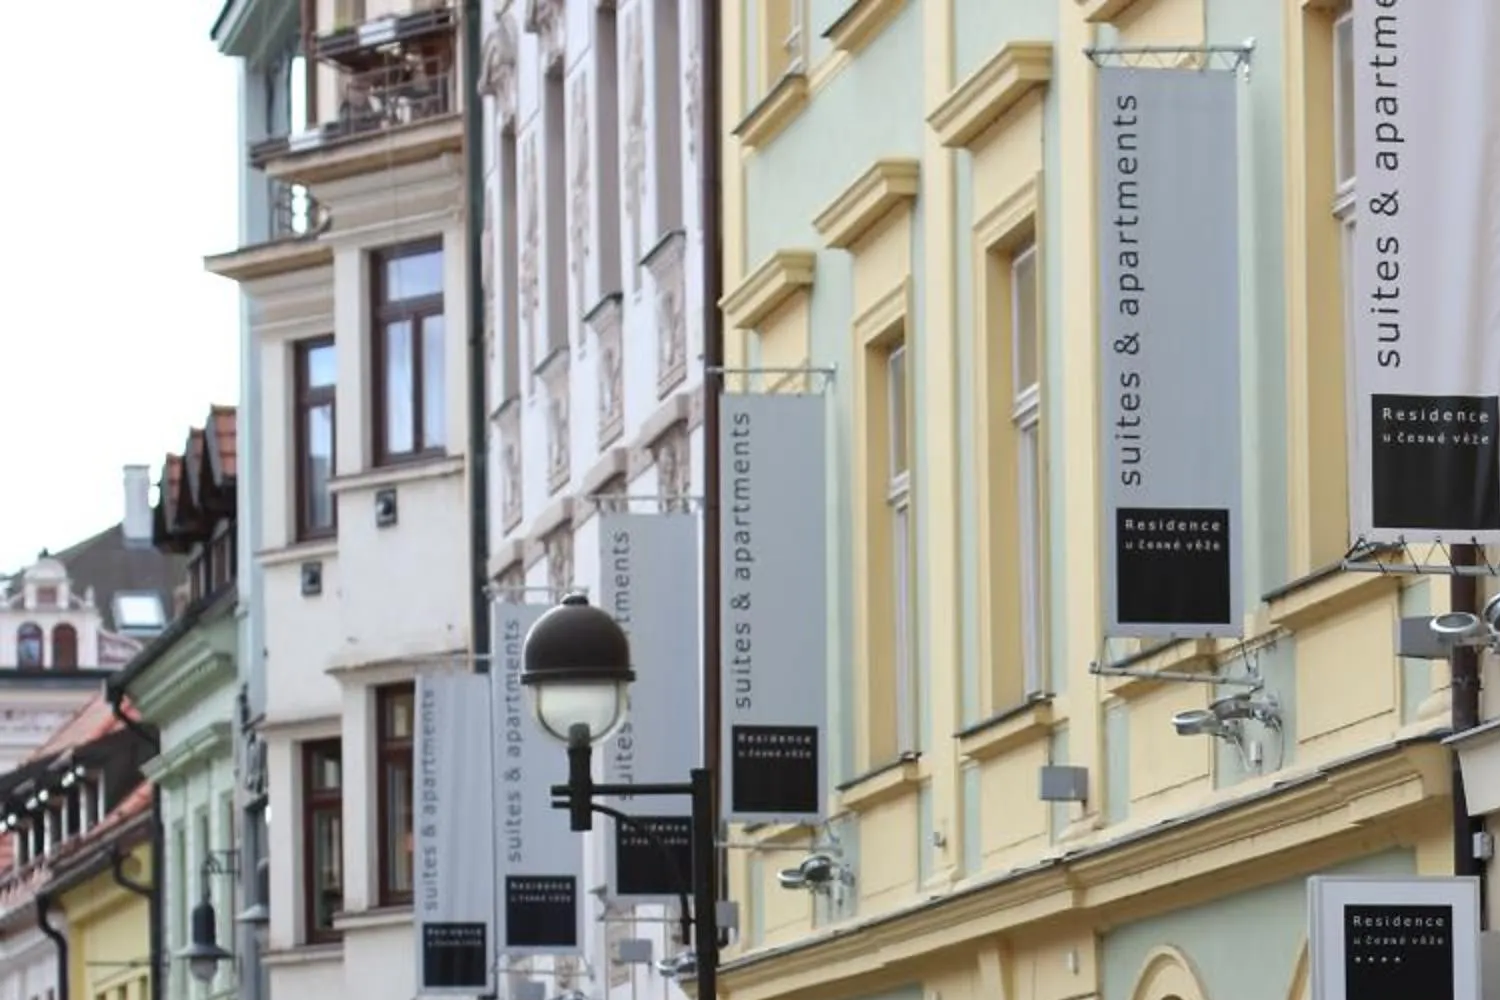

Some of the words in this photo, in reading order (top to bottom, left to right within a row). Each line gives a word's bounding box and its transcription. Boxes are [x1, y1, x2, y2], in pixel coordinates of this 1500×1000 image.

[1112, 93, 1145, 317] apartments
[1370, 190, 1400, 217] &
[1370, 236, 1401, 368] suites
[1113, 331, 1141, 355] &
[1114, 371, 1142, 487] suites
[1381, 407, 1490, 424] Residence
[730, 411, 755, 582] apartments
[1124, 517, 1222, 532] Residence
[611, 530, 633, 625] tments
[731, 592, 751, 611] &
[503, 618, 524, 759] apartments
[731, 622, 752, 709] suites
[504, 790, 523, 864] suites
[1352, 914, 1445, 927] Residence
